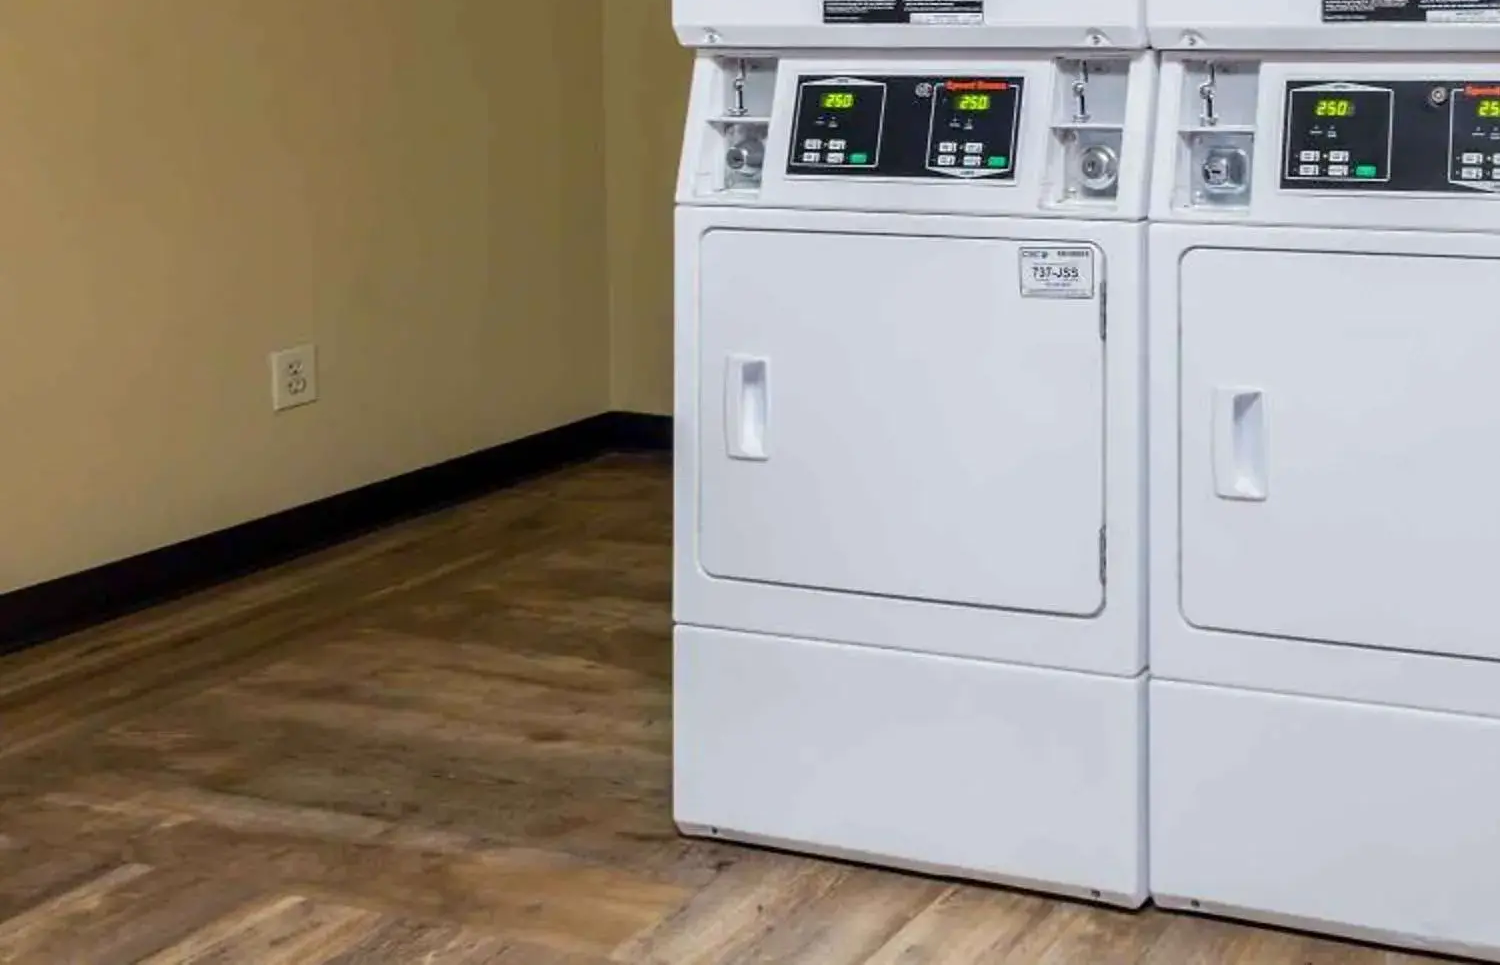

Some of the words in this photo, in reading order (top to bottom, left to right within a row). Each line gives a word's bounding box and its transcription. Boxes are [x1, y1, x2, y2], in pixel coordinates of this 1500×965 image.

[826, 94, 852, 108] 250
[958, 95, 988, 110] 250
[1315, 101, 1347, 116] 250
[1031, 266, 1079, 279] 737-JSS
